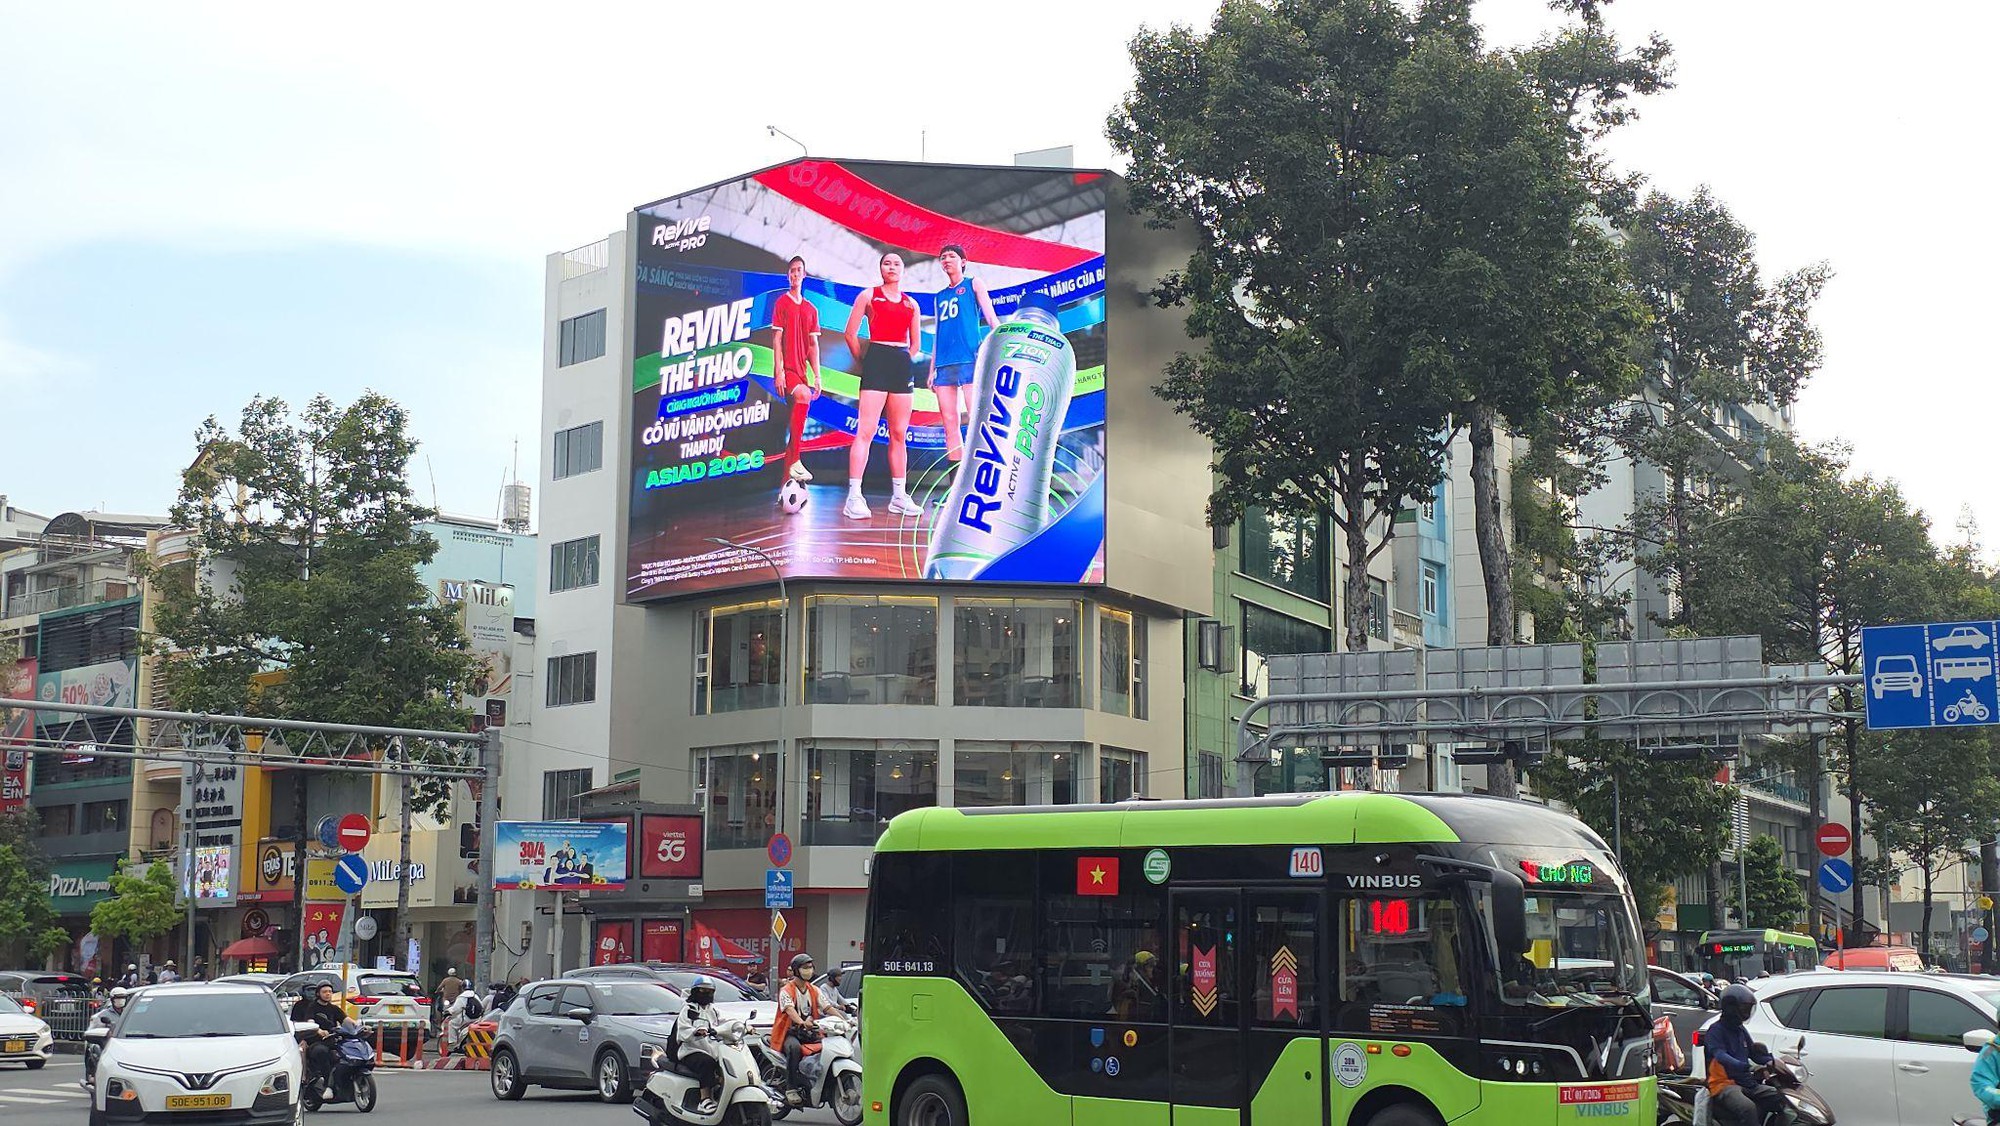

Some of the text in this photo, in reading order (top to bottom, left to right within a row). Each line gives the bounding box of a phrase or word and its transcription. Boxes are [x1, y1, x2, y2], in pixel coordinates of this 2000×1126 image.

[680, 234, 707, 253] PRO
[650, 266, 675, 287] SÁNG
[1050, 278, 1076, 298] NĂNG
[1076, 270, 1096, 289] CỦA
[939, 297, 959, 322] 26
[662, 297, 754, 358] REVIVE
[1005, 344, 1022, 358] 7
[1044, 337, 1063, 349] THAO
[660, 347, 754, 396] THỂ THAO
[726, 385, 741, 402] MỘ
[642, 399, 770, 445] CỔ VŨ VẬN ĐỘNG VIÊN
[1014, 382, 1046, 460] PRO
[681, 434, 725, 458] THAM DỰ
[646, 450, 765, 488] ASIAD 2026
[1007, 455, 1021, 501] ACTIVE
[863, 557, 877, 565] Minh
[3, 788, 24, 800] SIN
[520, 841, 545, 858] 30/4
[657, 839, 686, 862] 5G
[263, 857, 281, 873] TEXAS
[371, 860, 401, 881] MiLe
[1293, 851, 1320, 872] 140
[50, 874, 85, 896] PIZZA
[85, 881, 110, 892] Company
[1346, 875, 1421, 888] VINBUS
[1369, 900, 1409, 934] 140
[659, 925, 677, 933] DATA
[761, 938, 787, 952] FN
[884, 961, 934, 973] 50E-641.13
[1277, 975, 1292, 985] CỬA
[1279, 986, 1292, 996] LÊN
[172, 1097, 226, 1108] 50E-951.08
[1576, 1102, 1629, 1116] VINBUS
